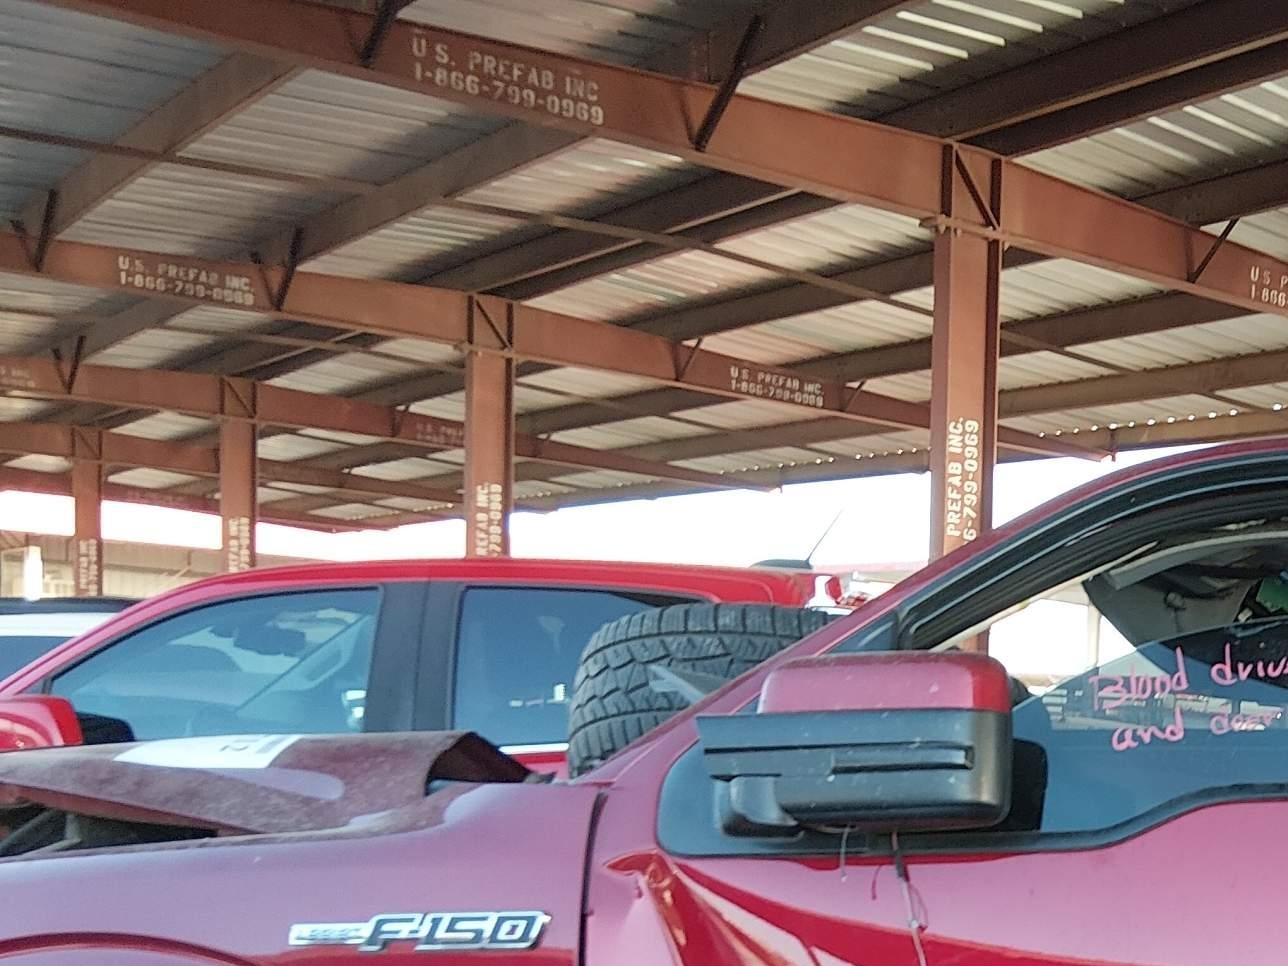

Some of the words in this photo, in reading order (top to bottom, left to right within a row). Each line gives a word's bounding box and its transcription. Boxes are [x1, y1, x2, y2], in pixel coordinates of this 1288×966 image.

[414, 61, 605, 127] 1-866-799-0969
[468, 51, 555, 91] PREFAB
[947, 416, 964, 454] INC.
[946, 461, 963, 538] PREFAB
[962, 419, 980, 541] 6-799-0969
[475, 512, 489, 556] REFAB
[1088, 645, 1190, 712] Blood
[1111, 702, 1185, 752] and
[358, 911, 551, 951] F-150
